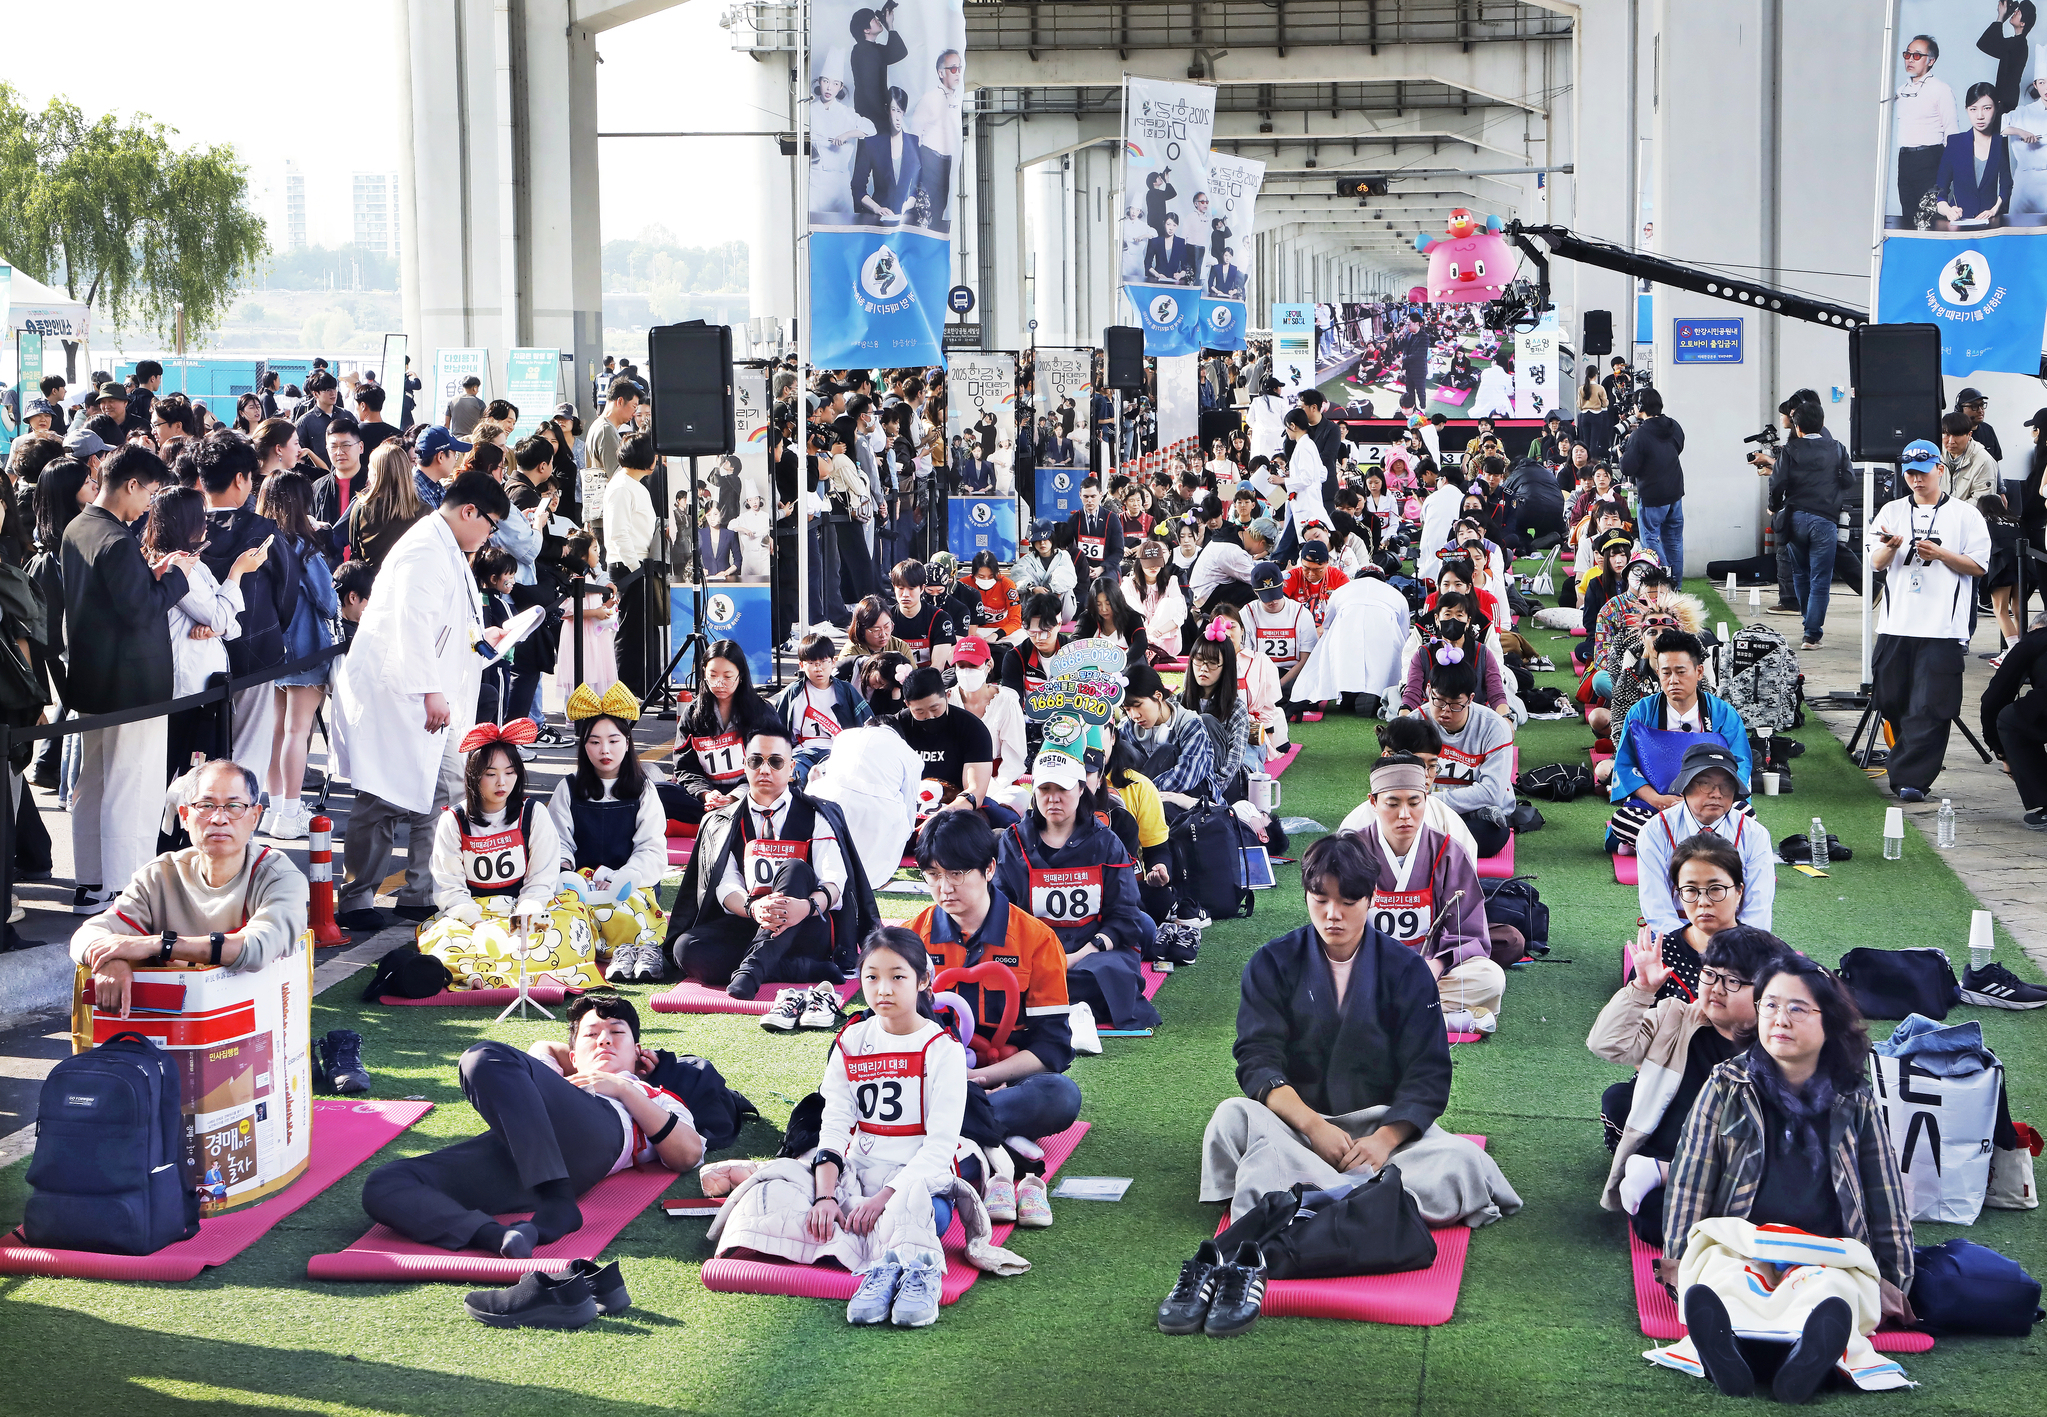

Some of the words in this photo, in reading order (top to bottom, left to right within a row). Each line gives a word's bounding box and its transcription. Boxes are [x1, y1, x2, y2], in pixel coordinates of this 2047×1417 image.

[1982, 286, 2007, 315] 허하라!
[1694, 327, 1738, 336] 한강시민공원내
[1679, 339, 1708, 349] 오토바이
[1710, 339, 1738, 349] 출입금지
[444, 353, 478, 363] 다회용기
[1038, 361, 1052, 372] 2025
[1051, 356, 1074, 372] 한강
[443, 364, 478, 374] 반납안내
[951, 369, 967, 381] 2025
[967, 362, 994, 381] 한강
[985, 389, 1003, 397] 대회
[735, 408, 760, 419] 리기
[737, 420, 749, 430] 회
[1369, 447, 1380, 460] 2
[1082, 543, 1099, 557] 36
[1264, 639, 1289, 657] 23
[1054, 648, 1120, 671] 1668-0120
[1077, 683, 1096, 696] 120
[1030, 694, 1107, 716] 1668-0120
[705, 748, 733, 774] 11
[1039, 754, 1067, 765] BOSTON
[1445, 762, 1474, 780] 14
[470, 839, 496, 849] 멍때리기
[497, 835, 512, 845] 대회
[781, 845, 795, 853] 대회
[473, 851, 515, 881] 06
[1043, 872, 1073, 882] 멍때리기
[1074, 871, 1088, 881] 대회
[1046, 889, 1090, 919] 08
[1375, 895, 1403, 904] 멍때리기
[1404, 895, 1421, 903] 대회
[1374, 911, 1419, 938] 09
[848, 1060, 887, 1074] 멍때리기
[888, 1059, 908, 1070] 대회
[857, 1081, 903, 1122] 03
[205, 1127, 252, 1157] 경매야
[227, 1153, 253, 1184] 놀자
